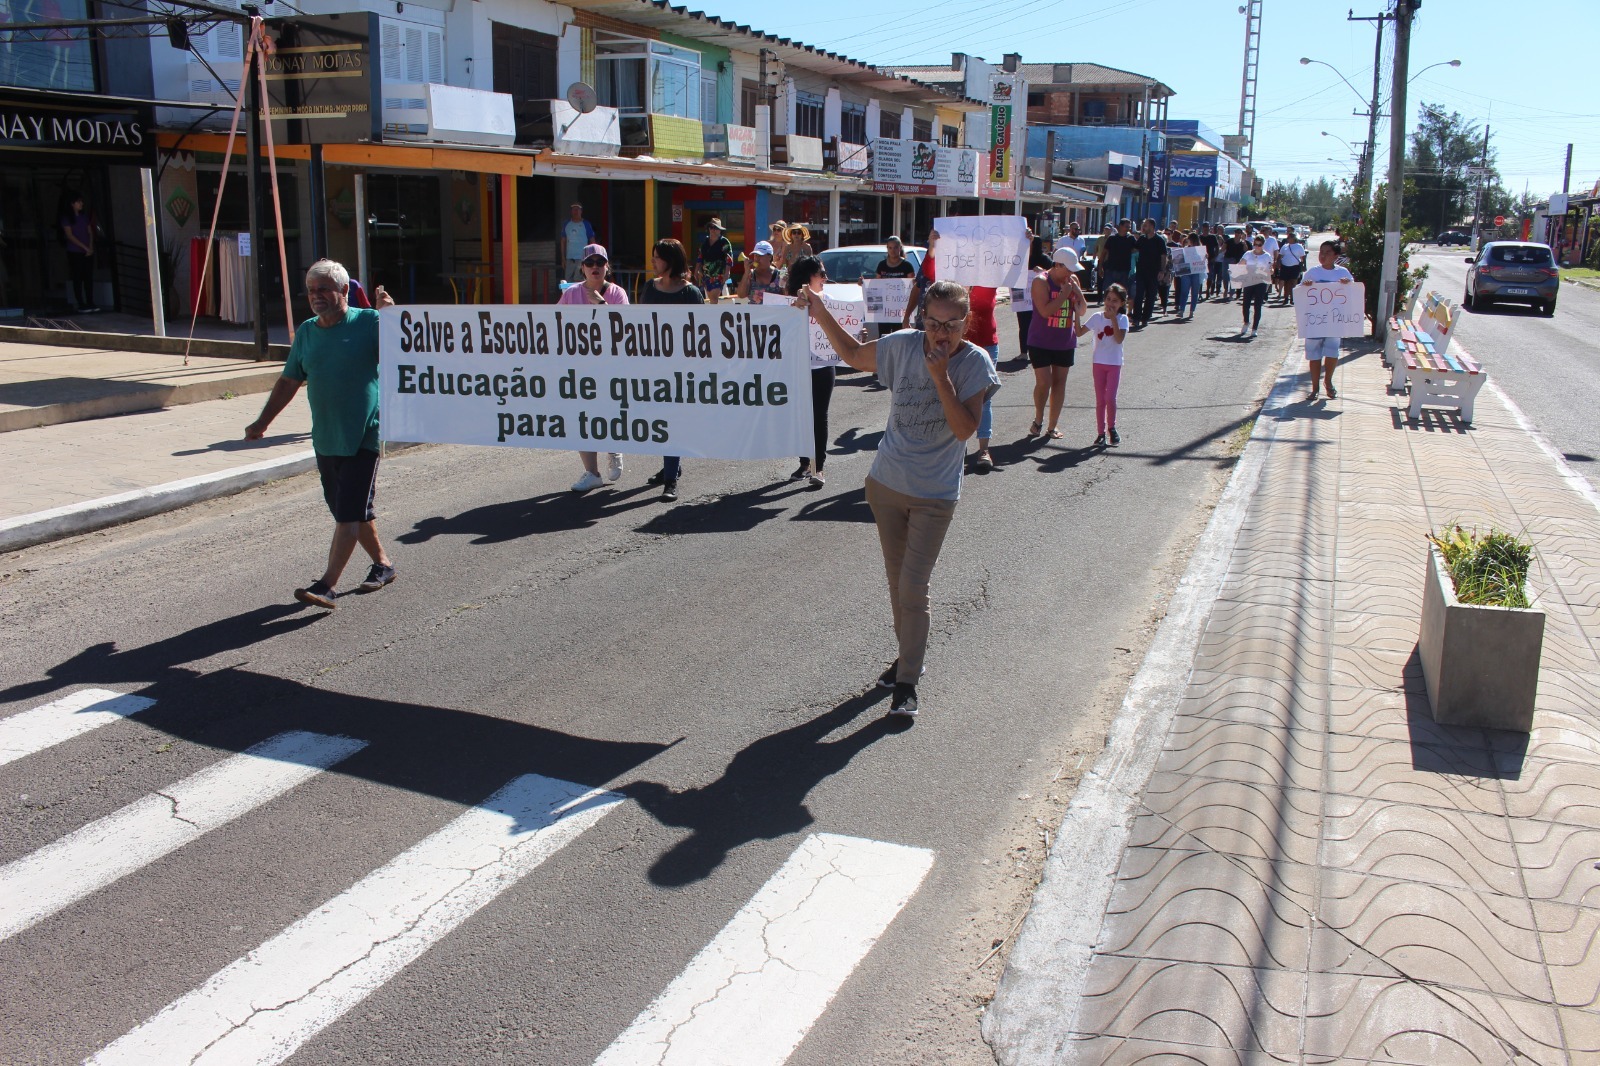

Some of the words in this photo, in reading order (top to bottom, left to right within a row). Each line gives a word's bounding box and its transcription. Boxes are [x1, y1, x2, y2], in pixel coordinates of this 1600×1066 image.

[313, 53, 361, 69] MODAS
[52, 118, 142, 145] MODAS
[995, 106, 1006, 145] GAÚCHO
[912, 170, 934, 179] GAÚCHO
[996, 148, 1004, 179] BAZAR
[1152, 166, 1161, 199] PanVel
[954, 225, 1003, 248] SOS
[983, 251, 1021, 266] PAULO
[1306, 287, 1348, 306] SOS
[1331, 307, 1361, 324] PAULO
[400, 310, 455, 353] Salve
[461, 321, 474, 354] a
[478, 311, 549, 355] Escola
[555, 308, 602, 356] José
[608, 311, 674, 358] Paulo
[682, 312, 712, 358] da
[720, 311, 782, 360] Silva
[397, 364, 546, 405] Educação
[558, 368, 597, 400] de
[609, 371, 789, 408] qualidade
[497, 410, 567, 443] para
[578, 410, 670, 444] todos
